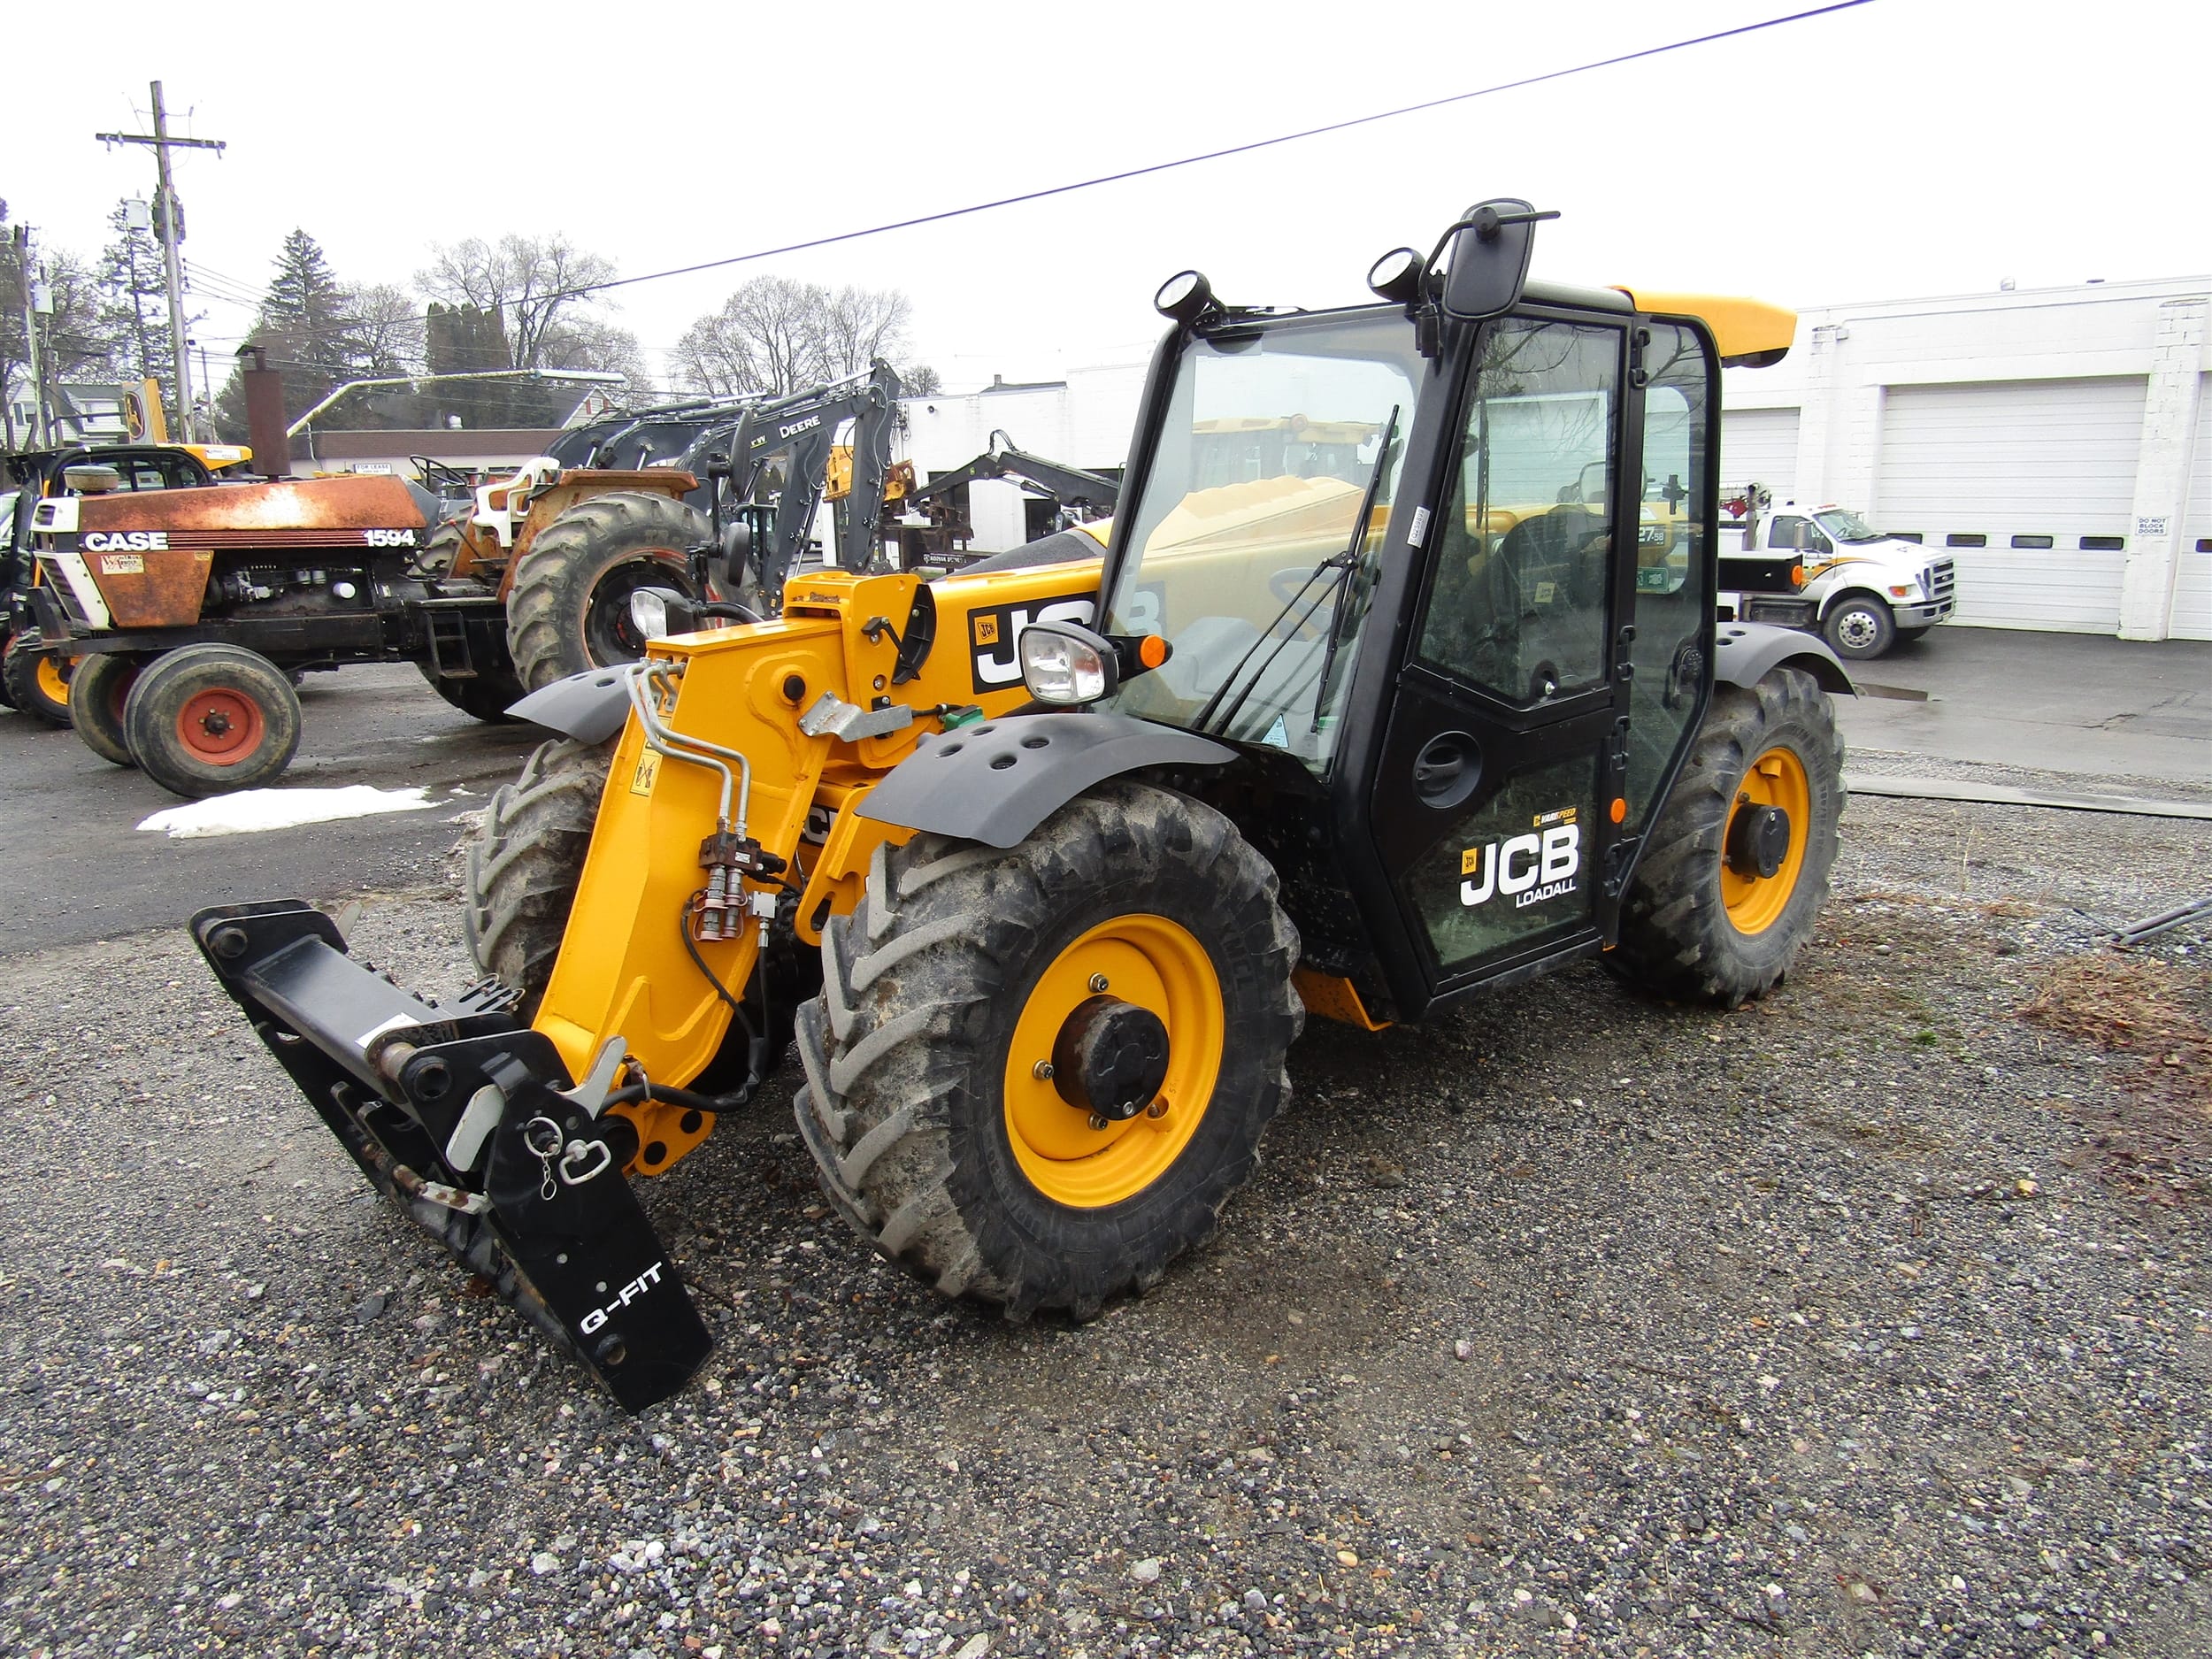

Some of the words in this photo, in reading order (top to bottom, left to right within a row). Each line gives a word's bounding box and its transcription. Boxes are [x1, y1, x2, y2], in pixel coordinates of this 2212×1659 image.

[779, 414, 822, 440] DEERE
[85, 532, 169, 551] CASE
[364, 529, 416, 547] 1594
[981, 621, 995, 637] JCB
[1461, 824, 1579, 906] JCB
[1516, 878, 1577, 909] LOADALL
[580, 1261, 662, 1334] Q-FIT
